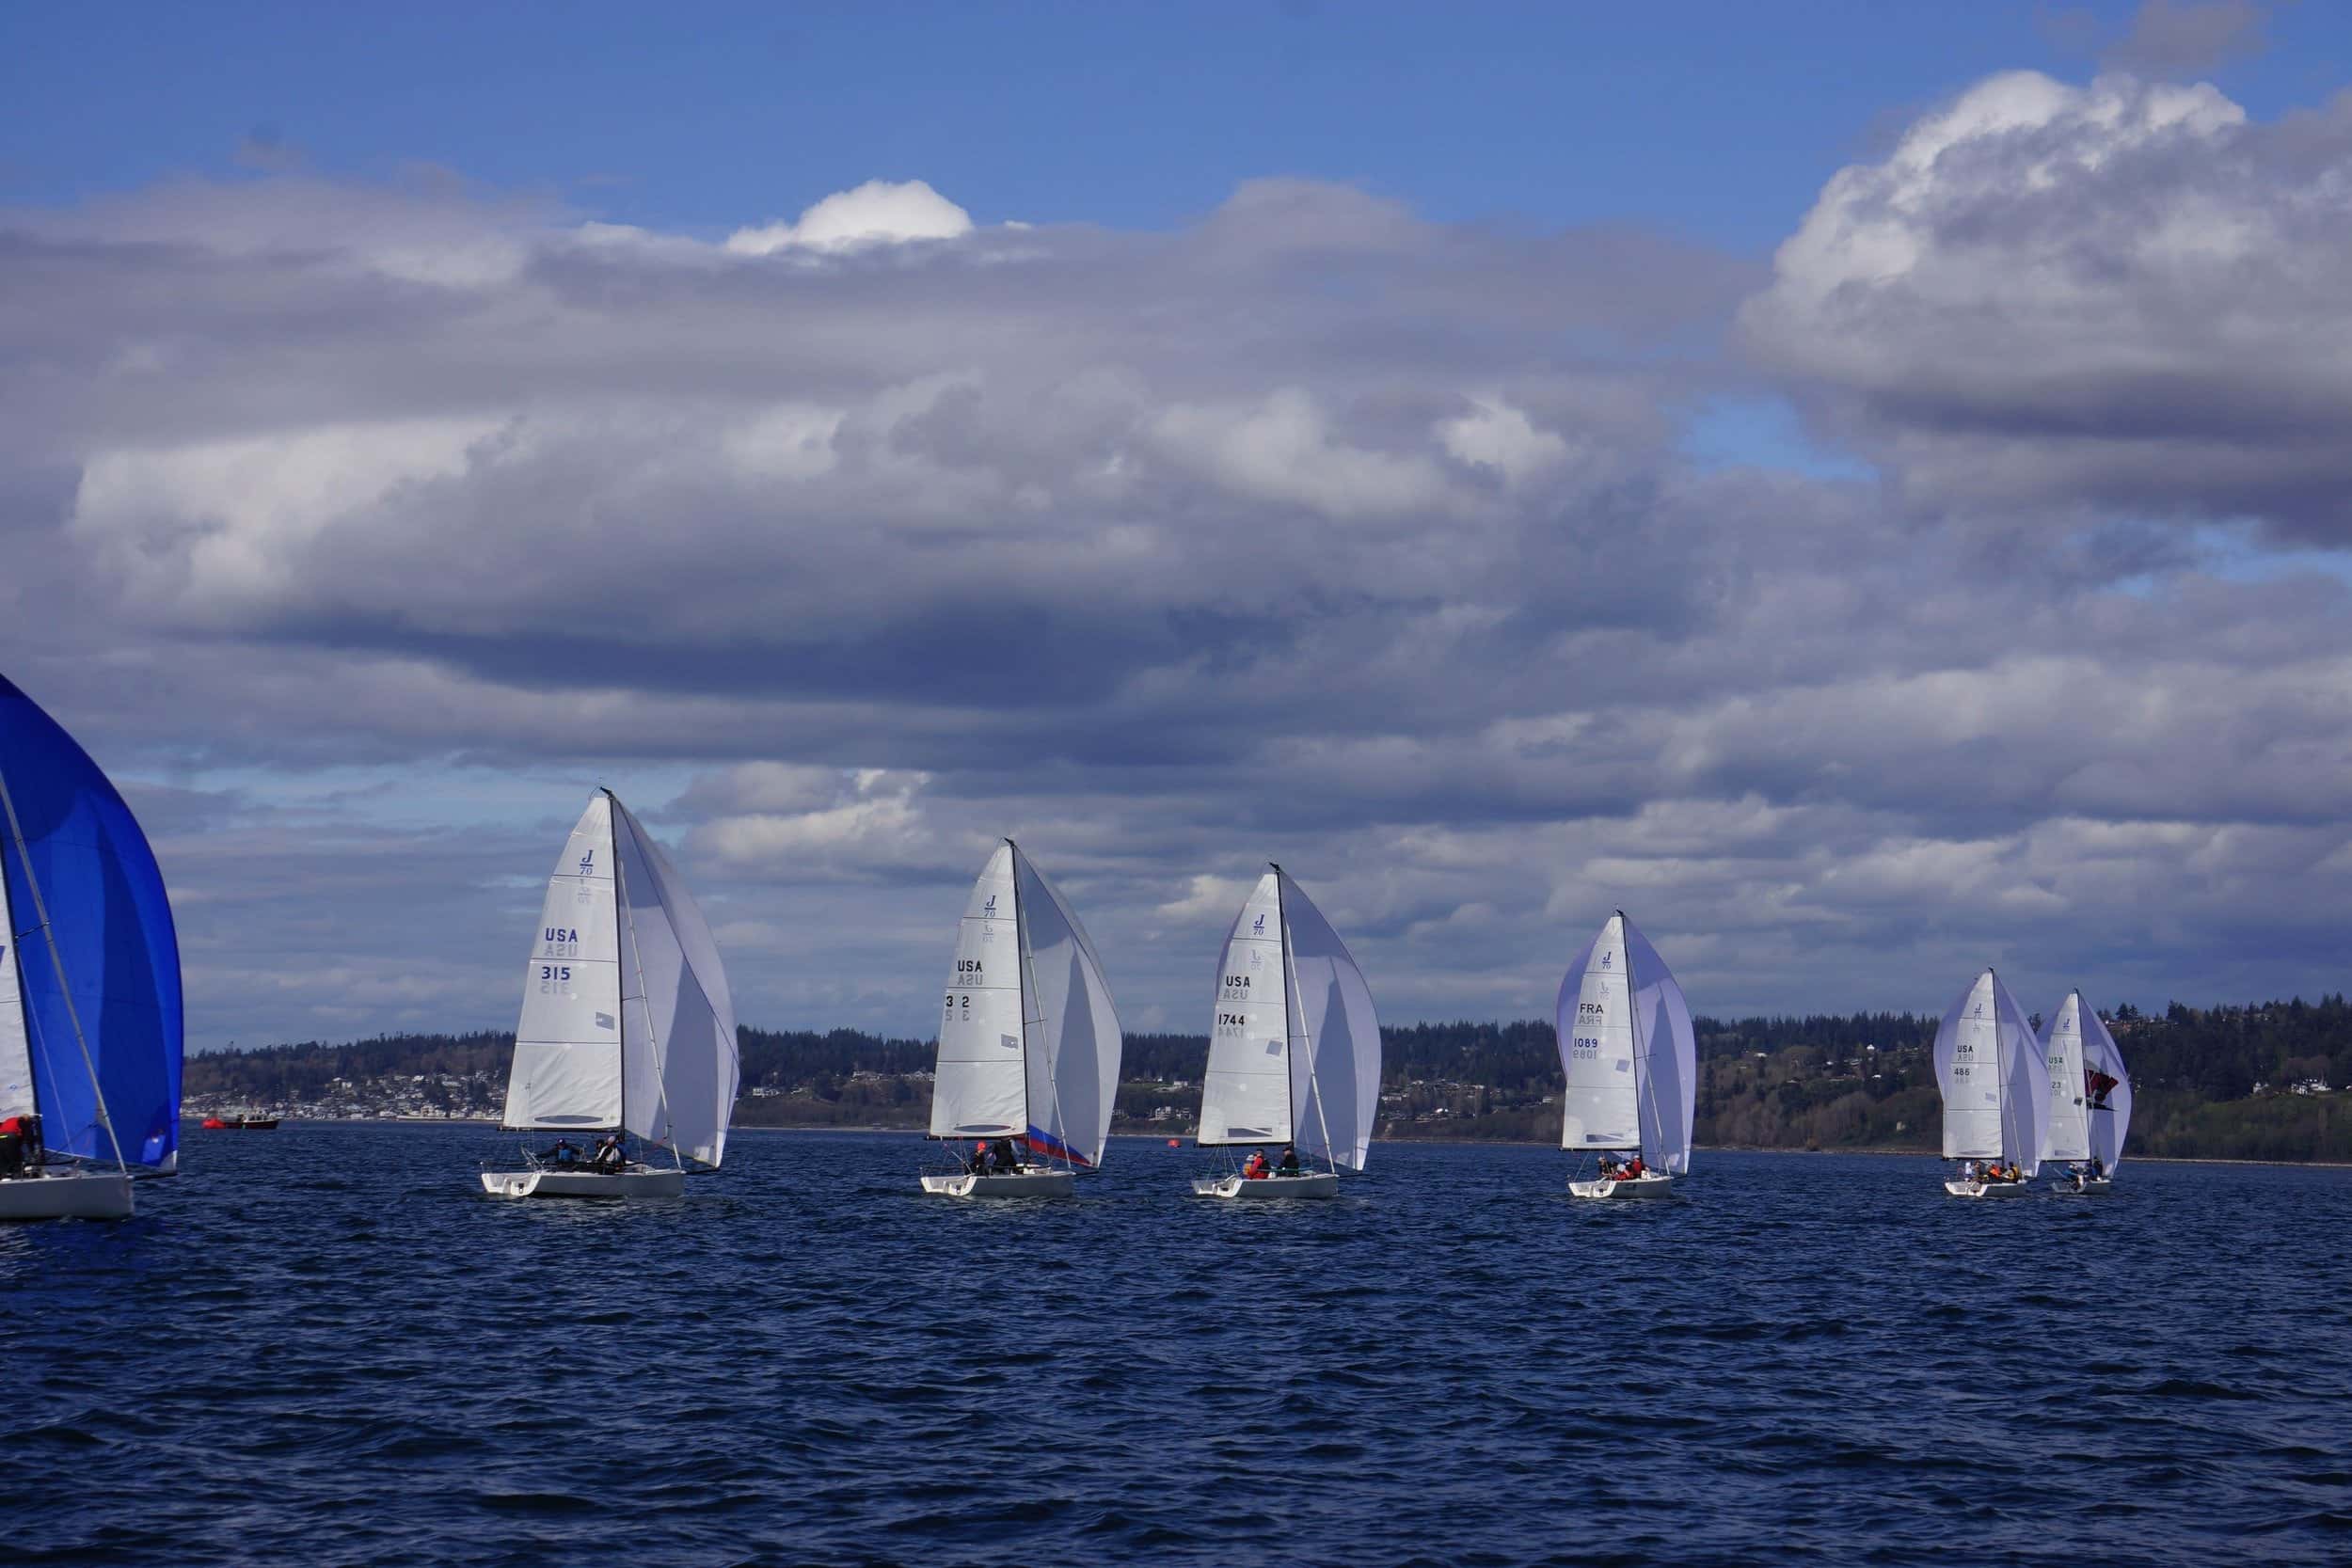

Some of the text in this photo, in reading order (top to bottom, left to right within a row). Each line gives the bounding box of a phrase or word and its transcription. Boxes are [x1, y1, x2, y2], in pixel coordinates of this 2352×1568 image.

[580, 849, 594, 863] J
[580, 866, 593, 876] 70
[985, 895, 996, 908] J
[984, 910, 995, 918] 70
[1254, 913, 1265, 926] J
[545, 927, 578, 942] USA
[1253, 927, 1264, 936] 70
[1602, 951, 1612, 961] J
[957, 959, 983, 973] USA
[541, 966, 570, 980] 315
[1226, 975, 1250, 988] USA
[1580, 1003, 1604, 1014] FRA
[1975, 1003, 1982, 1011] J
[1218, 1013, 1246, 1026] 1744
[1574, 1037, 1598, 1048] 1089
[1957, 1045, 1974, 1053] USA
